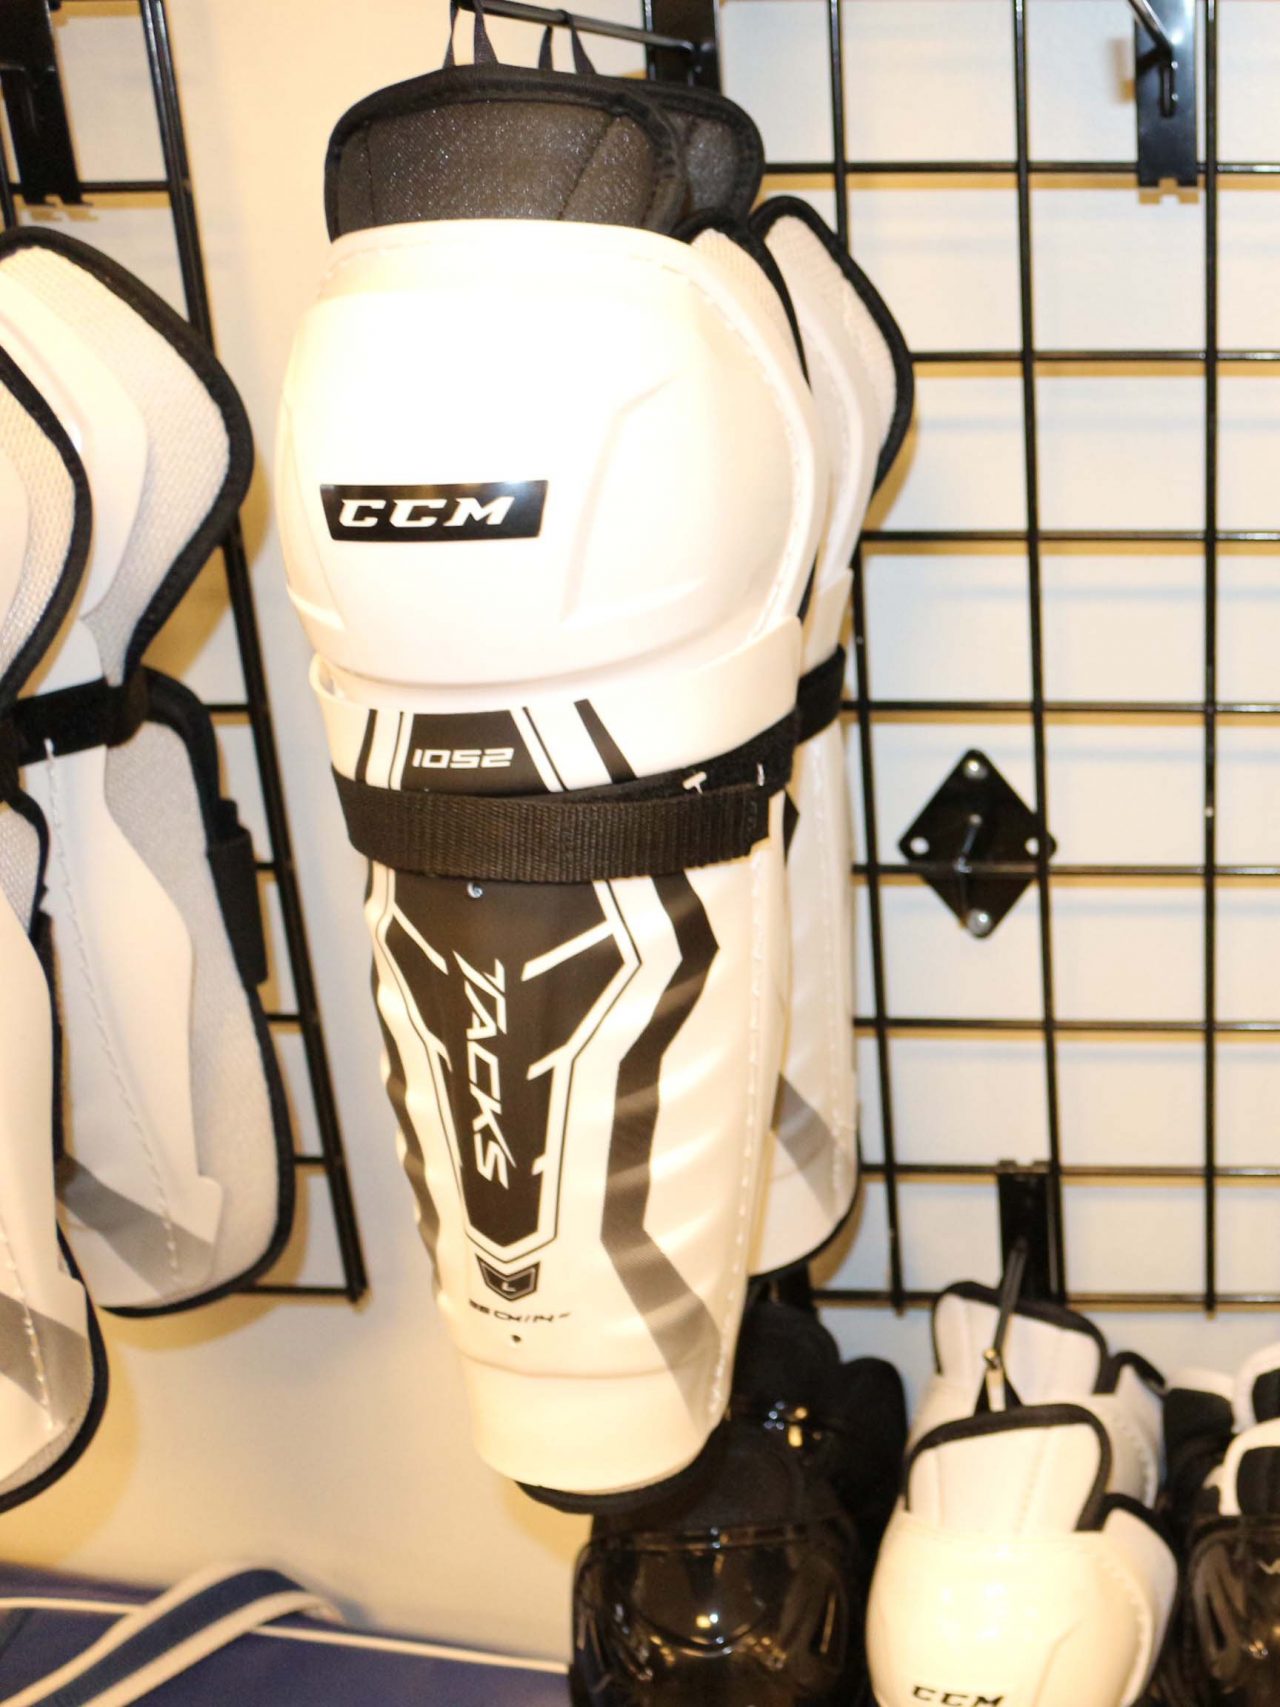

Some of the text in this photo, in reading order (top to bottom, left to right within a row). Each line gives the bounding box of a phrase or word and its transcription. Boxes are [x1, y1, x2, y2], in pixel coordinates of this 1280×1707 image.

[338, 497, 514, 528] CCM
[452, 950, 518, 1191] TACKS
[911, 1684, 1005, 1707] CCM
